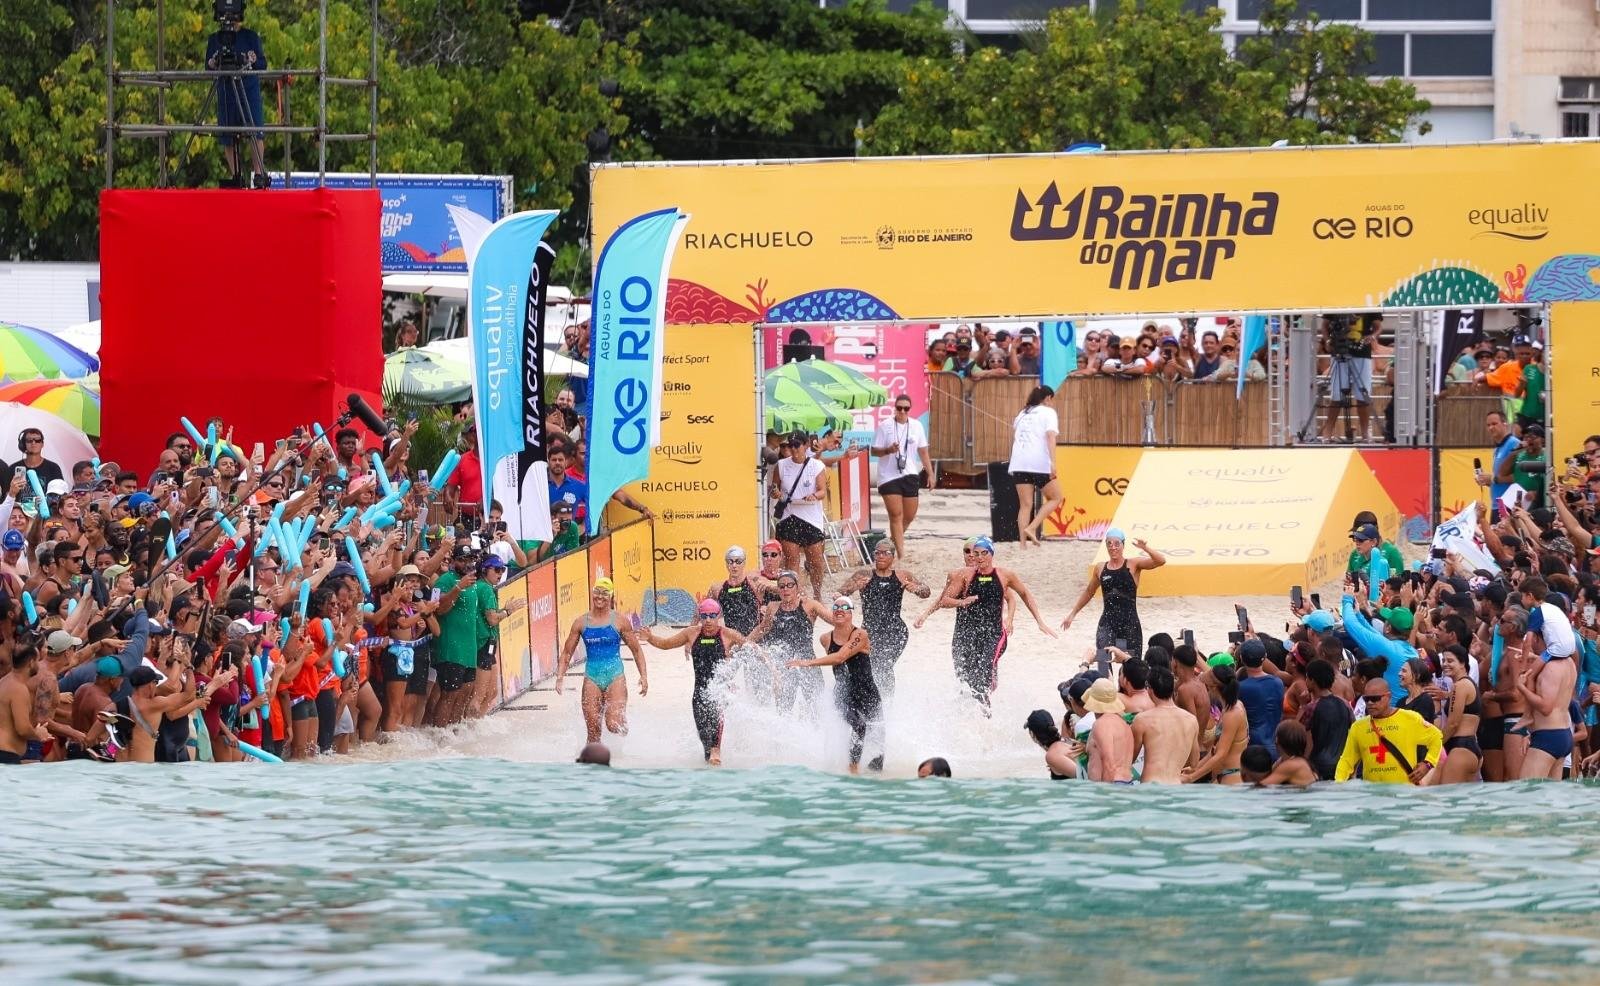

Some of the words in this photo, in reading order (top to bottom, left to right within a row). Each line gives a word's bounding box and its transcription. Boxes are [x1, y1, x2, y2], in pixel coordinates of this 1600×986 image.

[1082, 185, 1279, 240] Rainha
[1468, 203, 1549, 230] equaliv
[1365, 216, 1413, 238] RIO
[685, 230, 813, 249] RIACHUELO
[898, 235, 915, 243] RIO
[917, 234, 930, 242] DE
[931, 233, 973, 242] JANEIRO
[1080, 241, 1113, 265] do
[1109, 239, 1236, 290] mar
[603, 289, 611, 308] DO
[617, 275, 652, 361] RIO
[482, 284, 508, 411] equaliv
[505, 327, 514, 367] grupo
[526, 262, 541, 448] RIACHUELO
[662, 355, 683, 364] ffect
[685, 355, 710, 366] Sport
[674, 382, 692, 391] Rio
[687, 414, 715, 424] Sesc
[655, 442, 703, 459] equaliv
[1187, 465, 1292, 480] equaliv
[641, 481, 718, 492] RIACHUELO
[1131, 521, 1301, 531] RIACHUELO
[683, 547, 711, 561] RIO
[1208, 548, 1270, 556] RIO
